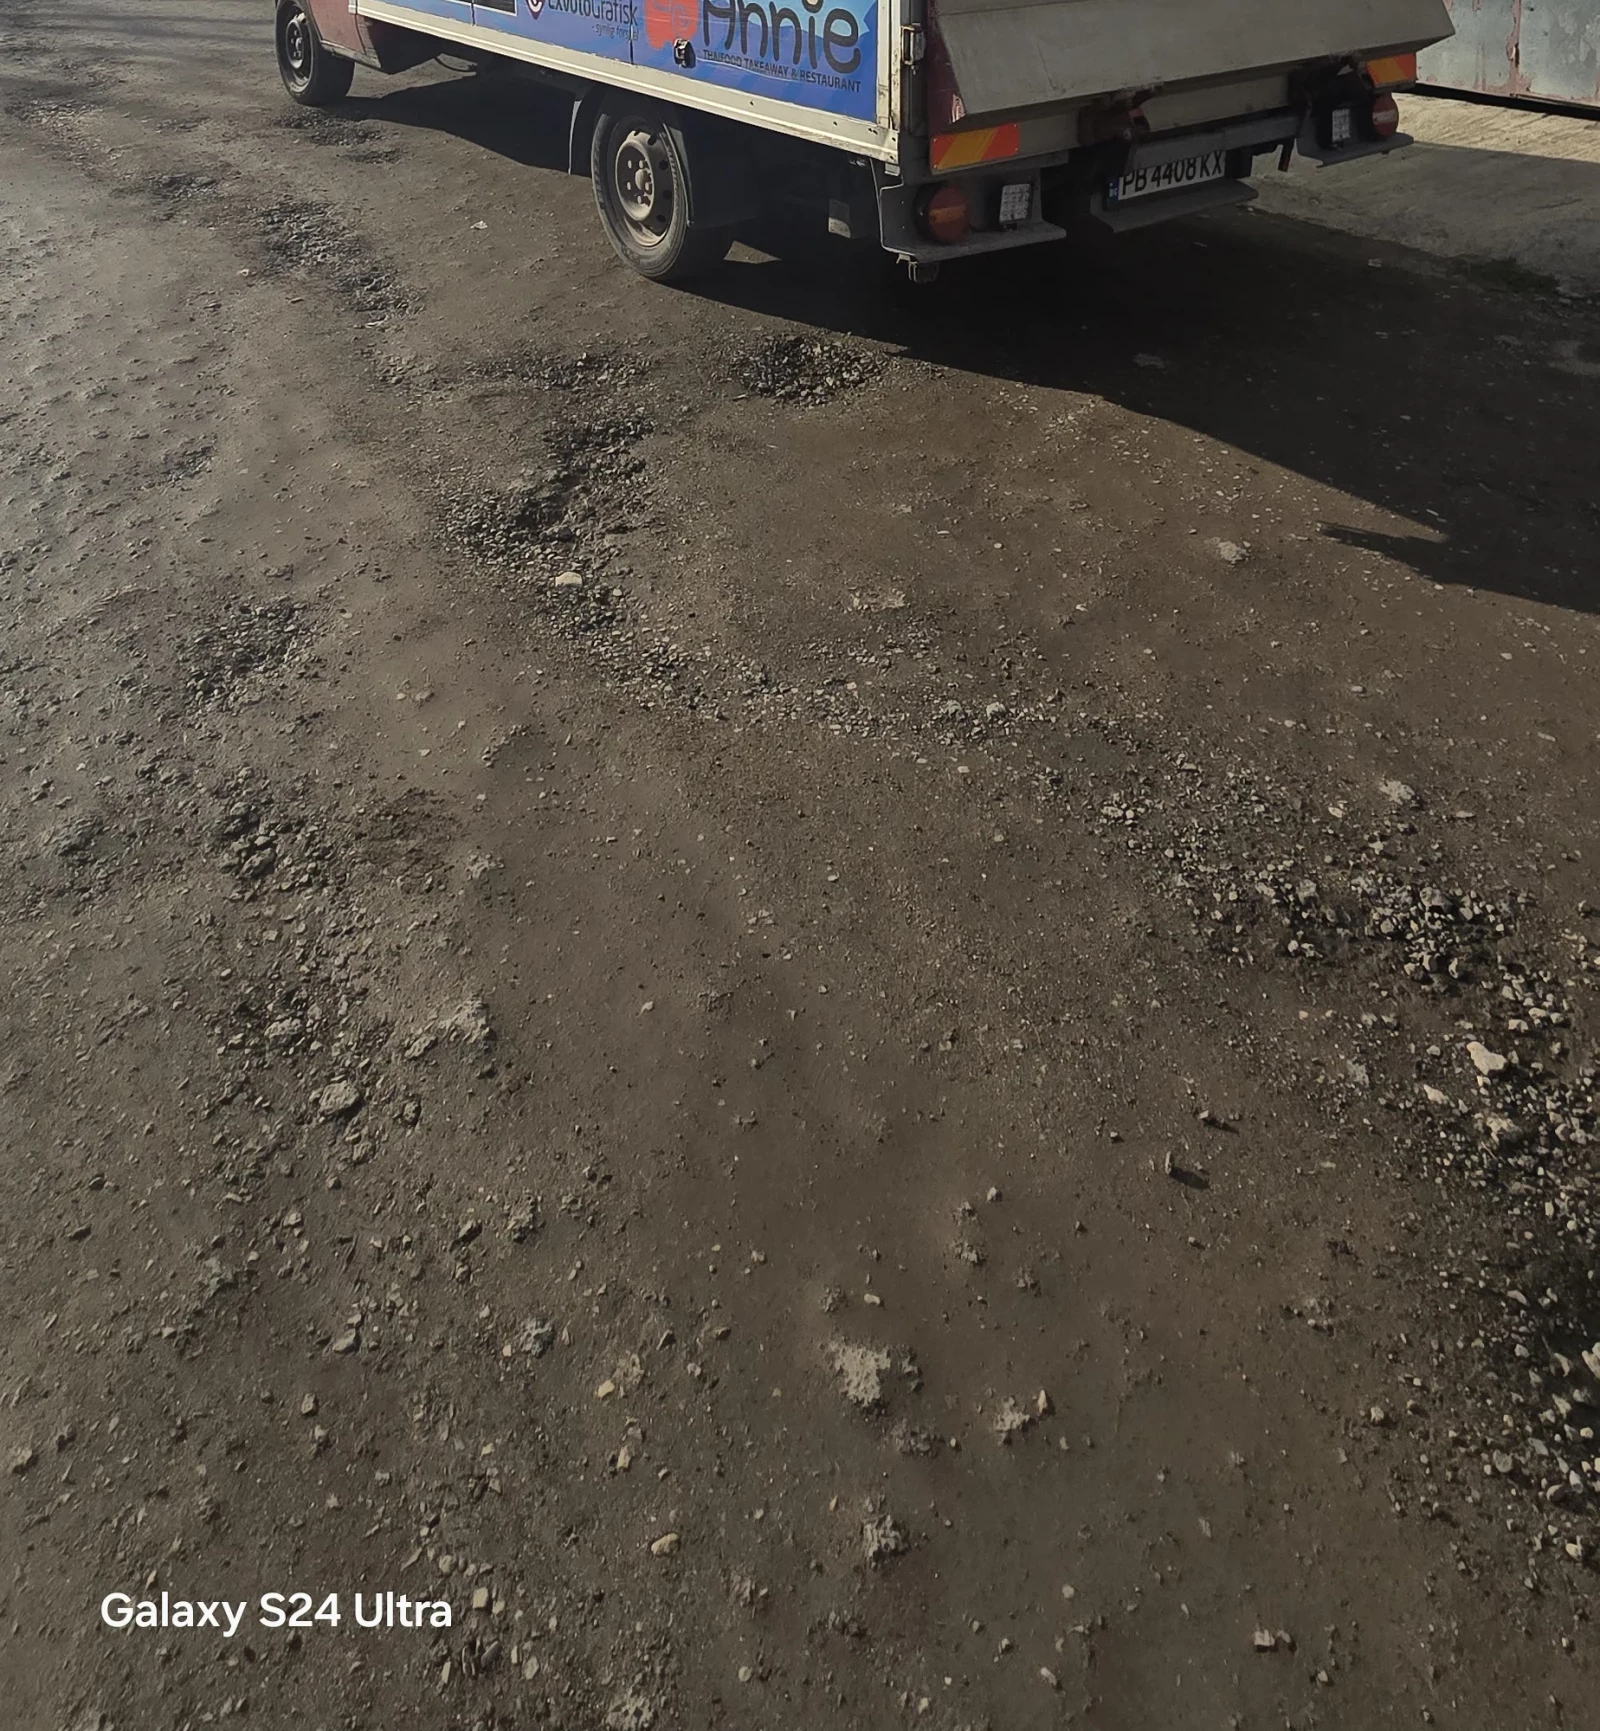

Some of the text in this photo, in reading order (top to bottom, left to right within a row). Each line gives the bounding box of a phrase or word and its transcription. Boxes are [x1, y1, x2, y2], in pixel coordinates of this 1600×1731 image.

[743, 57, 790, 79] TAKEAWAY
[800, 71, 862, 93] RESTAURANT
[1122, 150, 1222, 196] PB 4408 KX
